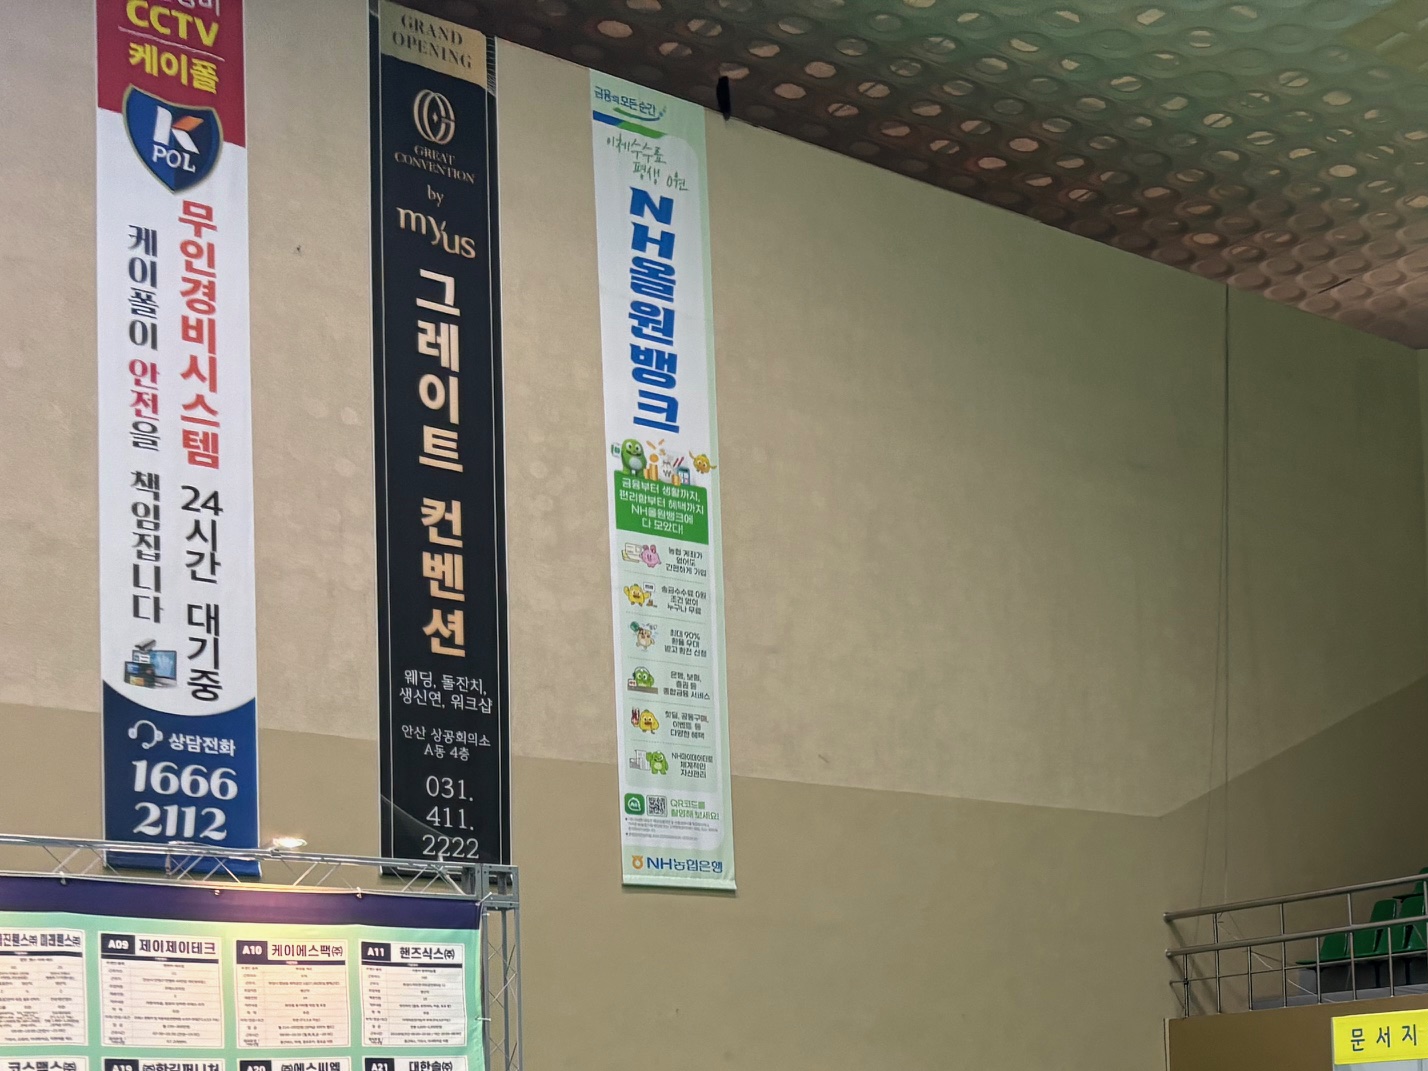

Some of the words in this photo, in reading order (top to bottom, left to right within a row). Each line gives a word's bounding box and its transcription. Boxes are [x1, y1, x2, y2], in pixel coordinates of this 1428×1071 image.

[126, 0, 219, 47] CCTV
[401, 13, 463, 46] GRAND
[392, 31, 472, 70] OPENING
[129, 42, 219, 94] 케이폴
[154, 106, 204, 154] K
[152, 144, 196, 173] POL
[394, 152, 476, 184] CONVENTION
[414, 144, 455, 166] GREAT
[427, 184, 444, 207] by
[127, 224, 158, 351] 케이폴이
[628, 186, 679, 434] NH올원뱅크
[177, 200, 220, 470] 무인경비시스템
[416, 268, 463, 472] 그레이트
[128, 358, 161, 451] 안전을
[130, 470, 164, 624] 책임집니다
[180, 486, 224, 584] 24시간
[420, 497, 466, 658] 컨벤션
[187, 604, 222, 702] 대기중
[404, 669, 436, 688] 웨딩,
[441, 674, 486, 696] 돌잔치,
[399, 687, 445, 709] 생신연,
[450, 694, 492, 714] 워크샵
[168, 731, 236, 757] 상담전화
[401, 724, 426, 740] 안산
[430, 728, 491, 747] 상공회의소
[424, 743, 446, 759] A동
[450, 746, 470, 762] 4층
[131, 760, 238, 800] 1666
[426, 776, 474, 802] 031.
[132, 802, 227, 840] 2112
[426, 806, 474, 832] 411.
[422, 834, 480, 859] 2222
[646, 856, 723, 874] NH농협은행
[108, 939, 130, 950] A09
[139, 939, 216, 954] 제이제이테크
[242, 946, 262, 955] A10
[367, 947, 384, 956] A11
[371, 1063, 388, 1071] A21
